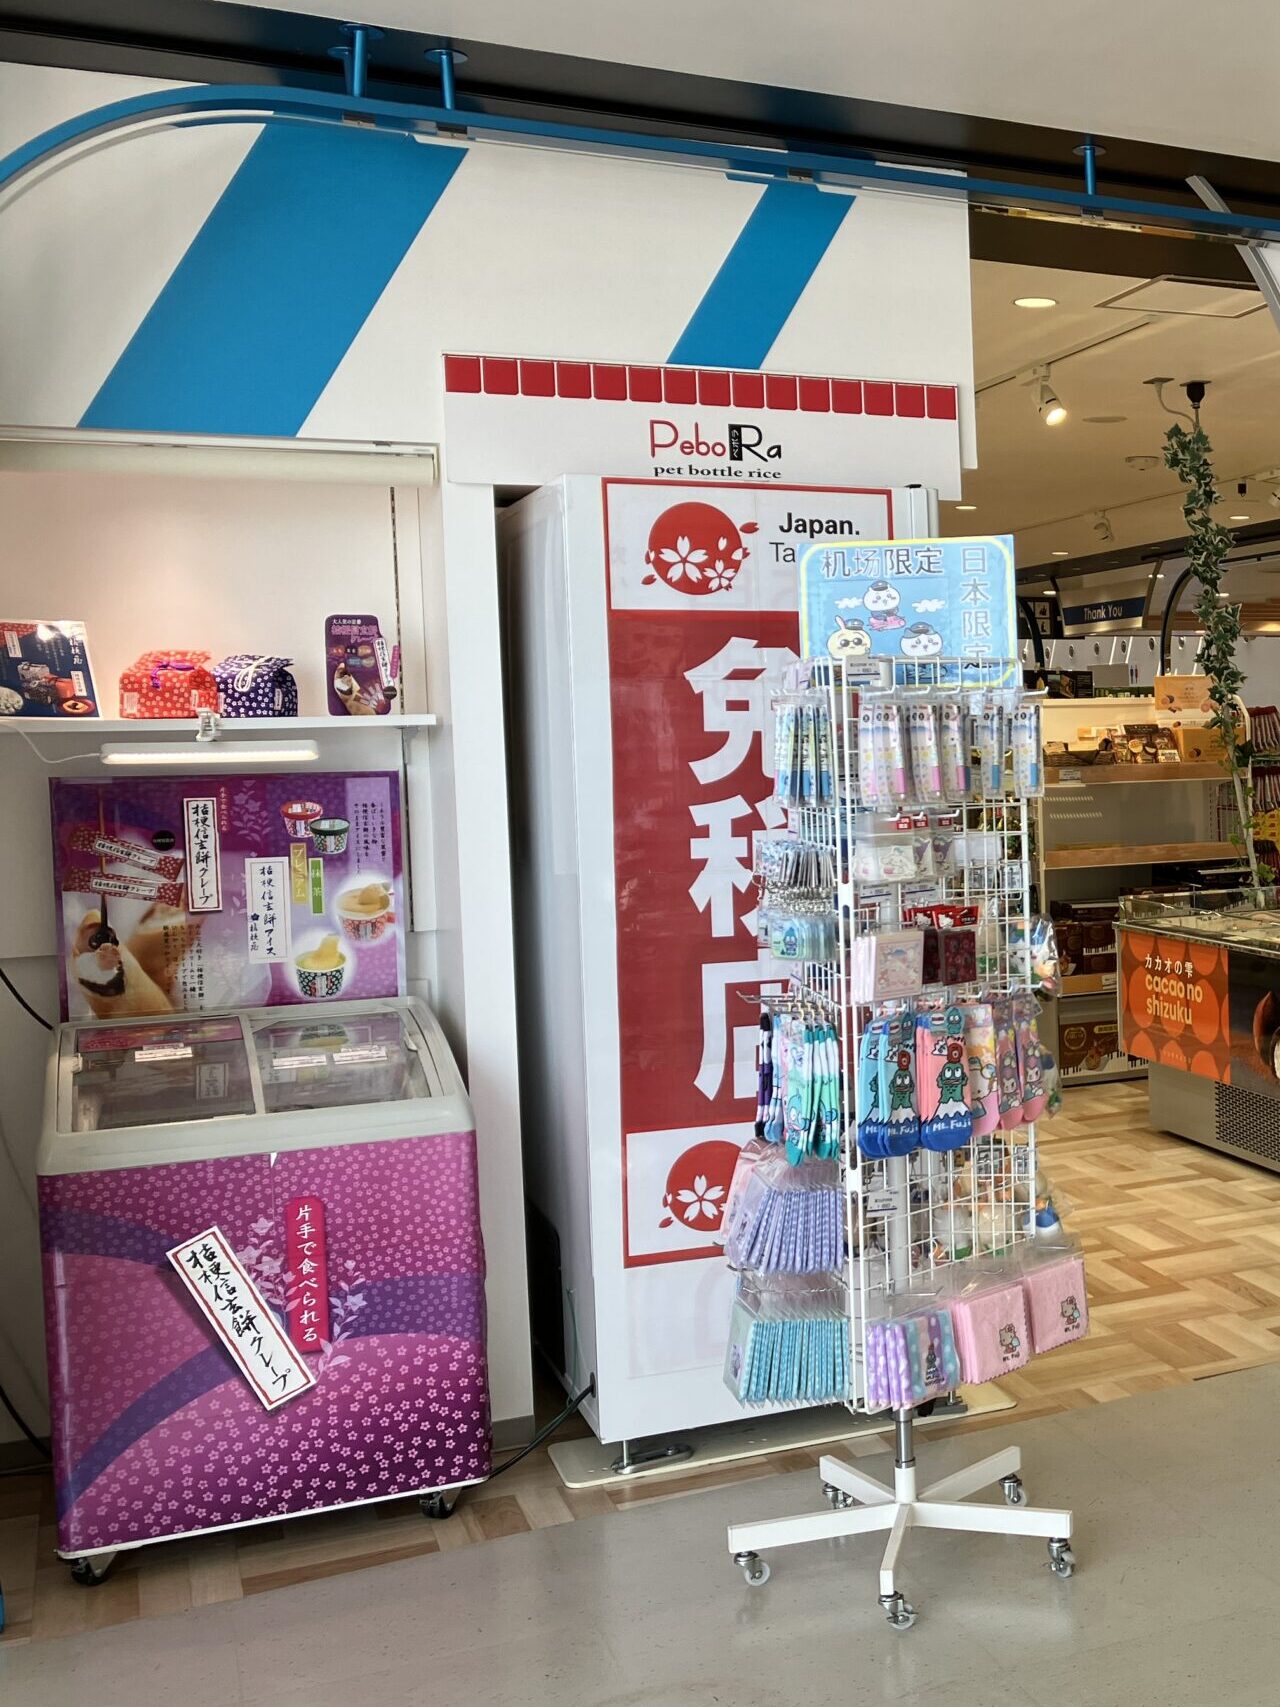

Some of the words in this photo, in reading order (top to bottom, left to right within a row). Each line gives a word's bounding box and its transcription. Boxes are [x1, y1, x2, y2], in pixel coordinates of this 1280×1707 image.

[653, 465, 684, 477] pet
[688, 464, 743, 477] bottle
[748, 468, 782, 479] rice
[778, 512, 861, 539] Japan.
[768, 541, 796, 563] Ta
[821, 546, 944, 579] 机场限定
[1083, 606, 1106, 621] Thank
[1108, 604, 1123, 617] You
[191, 803, 214, 906] 桔梗信玄餅クレープ
[259, 865, 278, 957] 桔梗信玄餅アイス
[1145, 953, 1194, 979] カカオの雫
[1145, 974, 1185, 1000] cacao
[1187, 984, 1203, 1003] no
[1146, 997, 1192, 1025] shizuku
[900, 1124, 918, 1136] Fuji
[950, 1118, 971, 1130] Fuji
[296, 1204, 320, 1343] 片手で食べられる
[186, 1243, 291, 1393] 桔梗信玄餅クレープ
